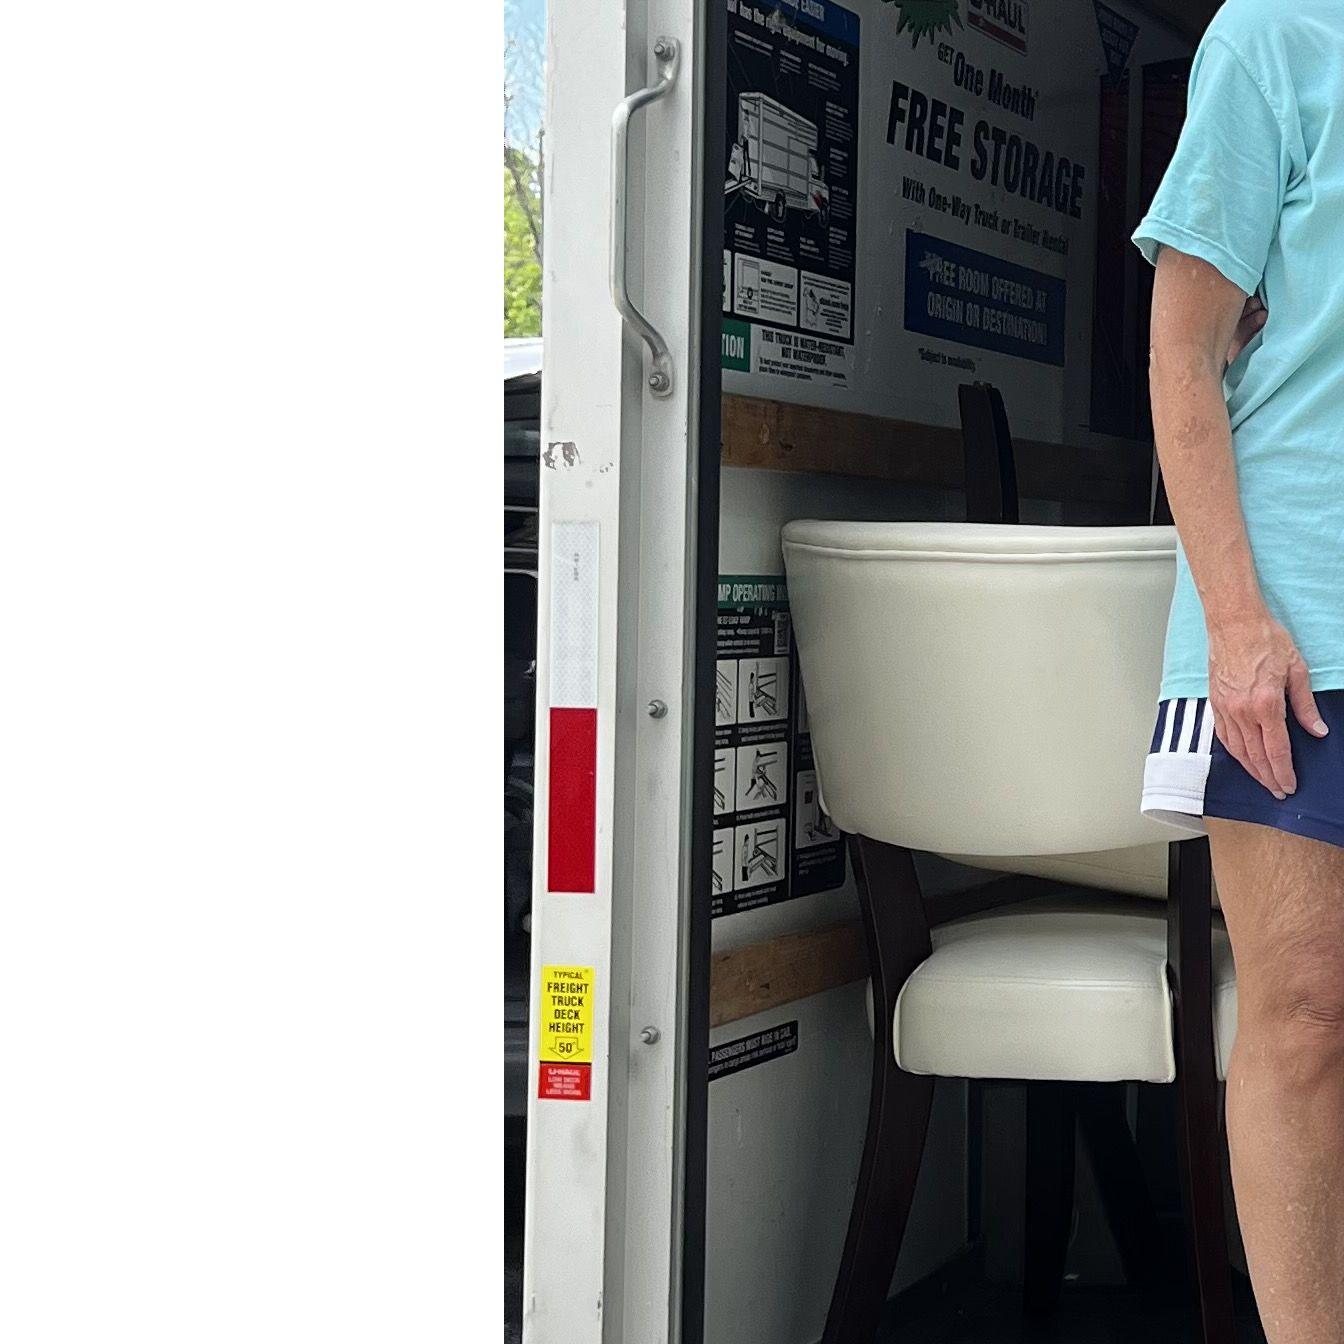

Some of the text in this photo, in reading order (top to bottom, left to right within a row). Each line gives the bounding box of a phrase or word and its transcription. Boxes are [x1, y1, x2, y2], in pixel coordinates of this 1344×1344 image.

[937, 42, 955, 66] GET
[953, 52, 984, 97] One
[886, 79, 1086, 220] FREE STORAGE
[902, 176, 926, 205] With
[928, 186, 972, 226] One-Way
[973, 203, 999, 232] Truck
[1001, 218, 1011, 235] or
[1013, 217, 1042, 245] Trailer
[958, 265, 990, 298] ROOM
[991, 275, 1035, 310] OFFERED
[1034, 289, 1048, 313] AT
[927, 291, 965, 325] ORIGIN
[966, 302, 982, 329] OR
[732, 583, 776, 602] OPERATING
[553, 970, 584, 980] TYPICAL
[547, 981, 590, 995] FREIGHT
[551, 995, 584, 1007] TRUCK
[554, 1009, 581, 1021] DECK
[549, 1022, 585, 1034] HEIGHT
